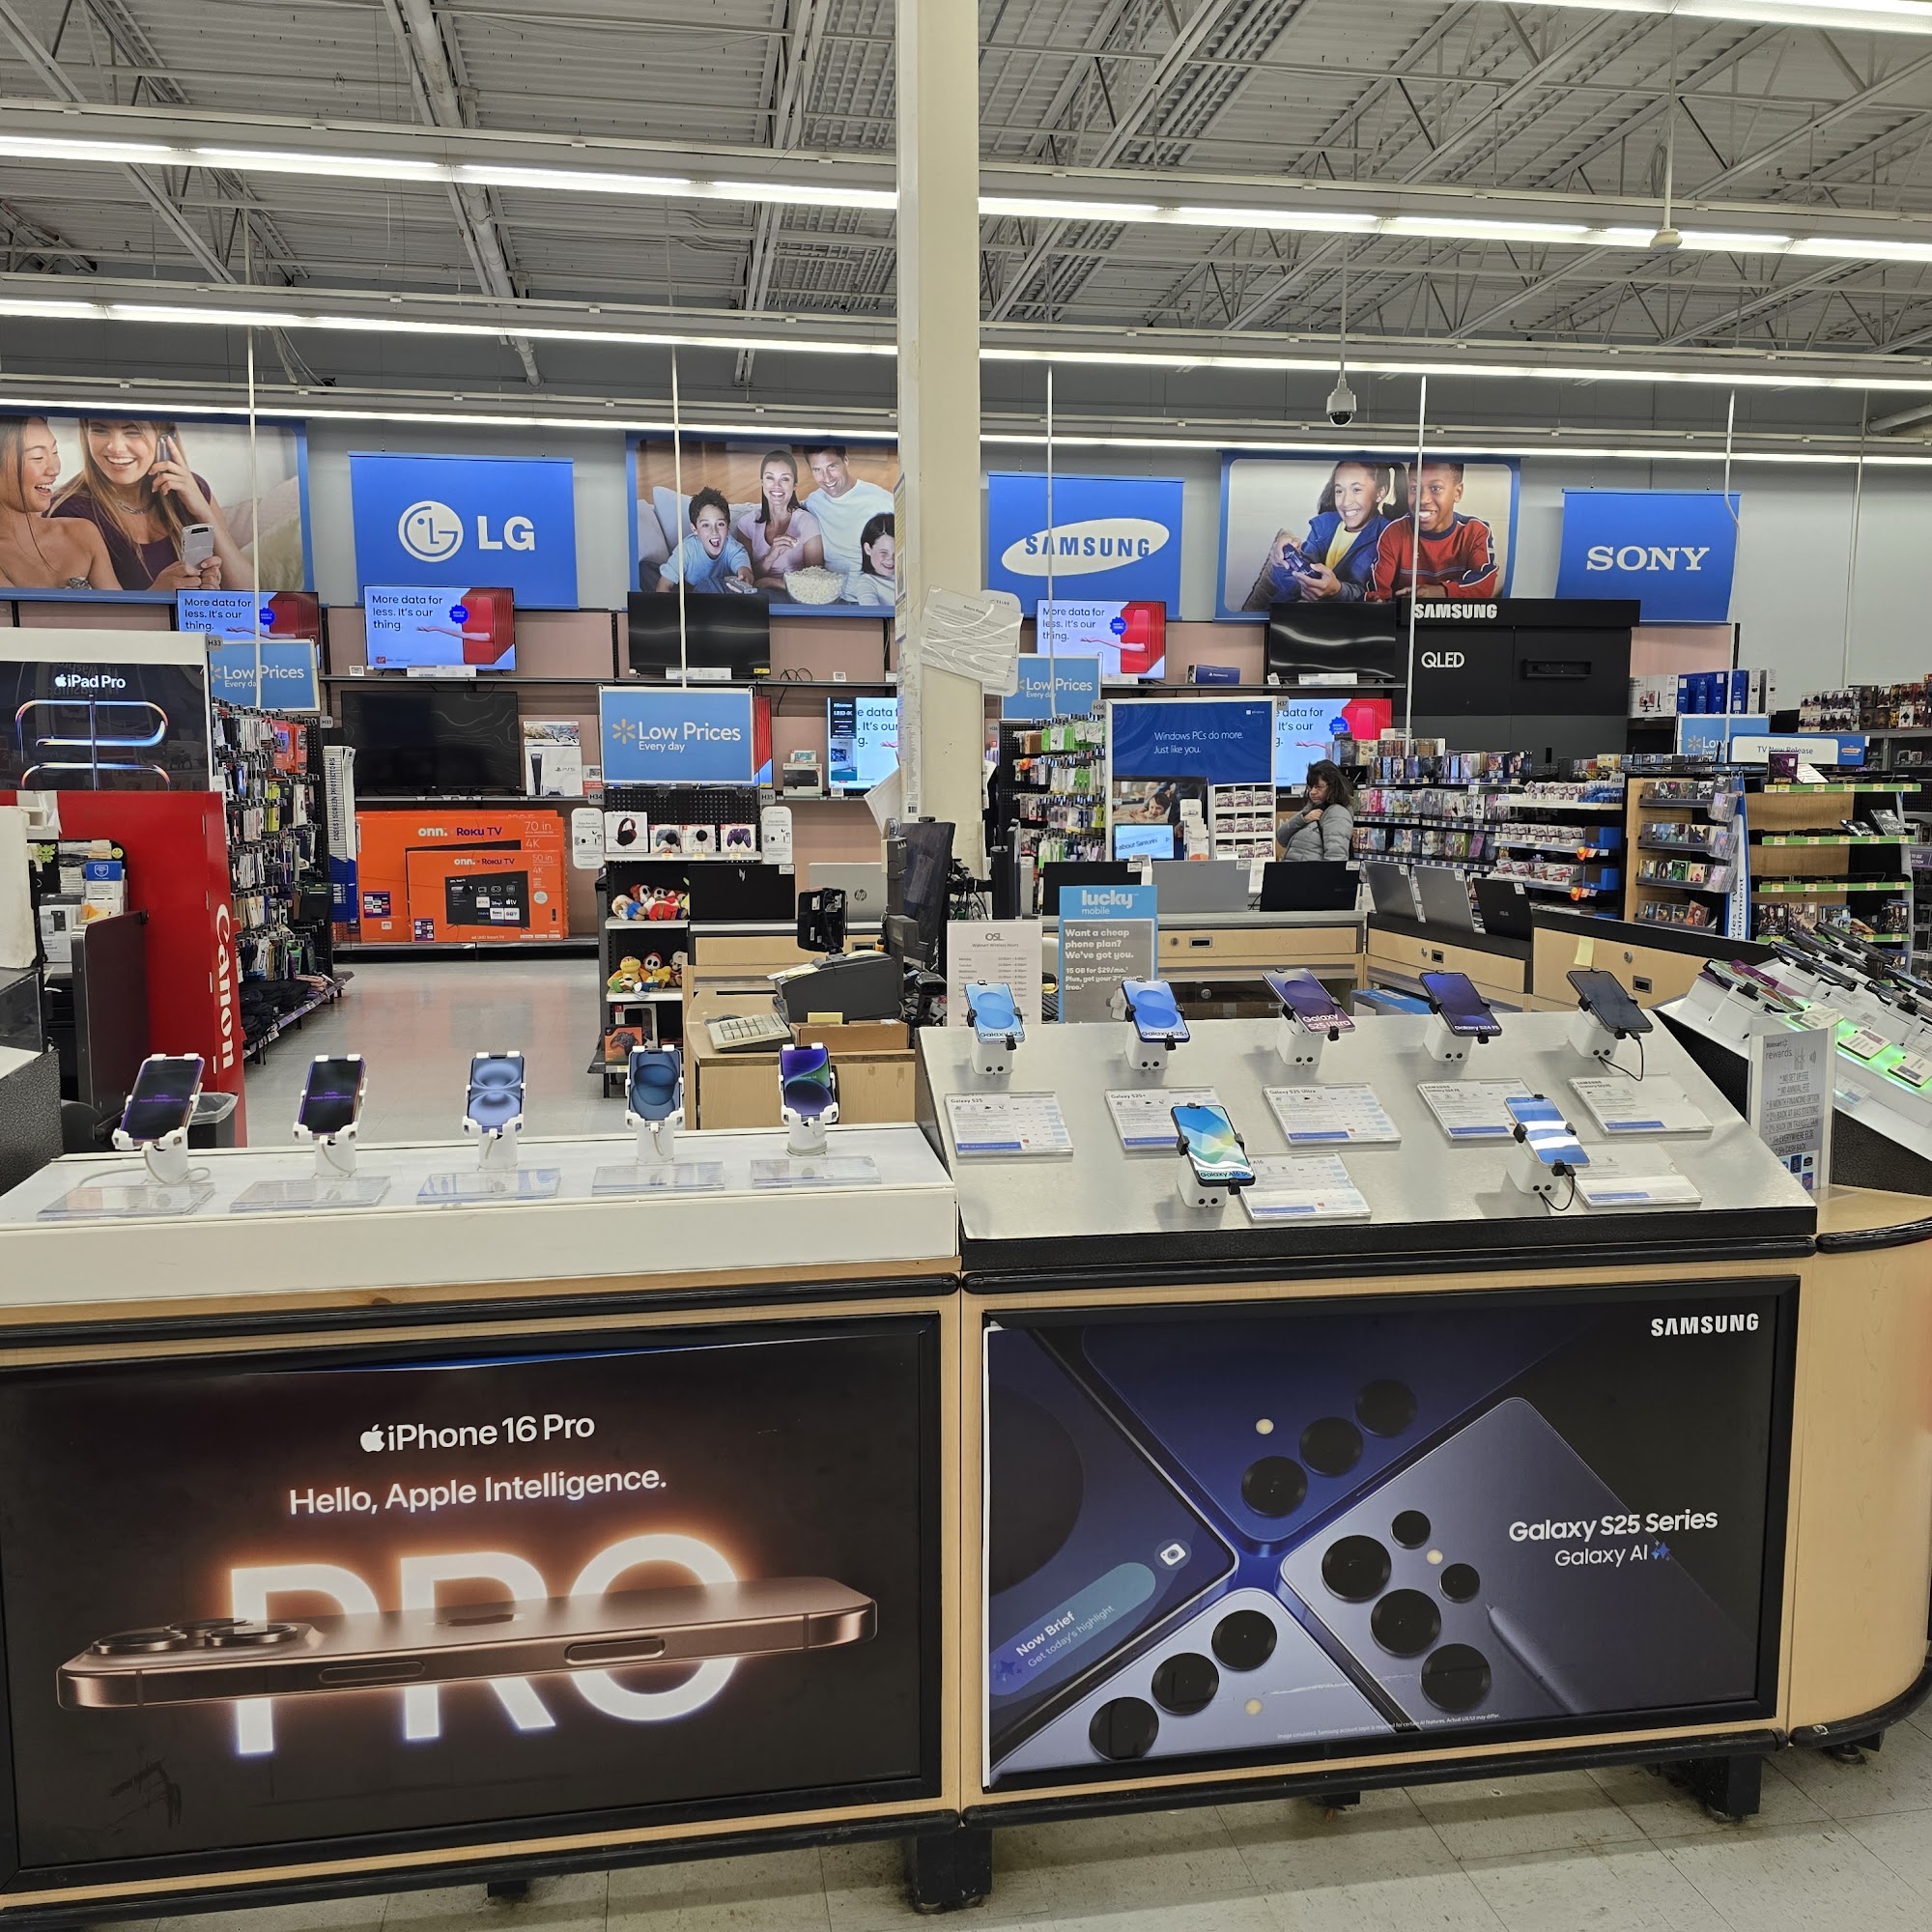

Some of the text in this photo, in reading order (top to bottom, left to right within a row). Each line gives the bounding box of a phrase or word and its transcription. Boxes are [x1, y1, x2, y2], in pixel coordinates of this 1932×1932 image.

[477, 516, 535, 551] LG
[1025, 535, 1150, 557] SAMSUNG
[1586, 545, 1710, 571] SONY
[184, 597, 251, 609] More data for
[372, 595, 443, 606] More data for
[184, 609, 242, 619] less. It's our
[372, 607, 434, 617] less. It's our
[1042, 607, 1105, 616] More data for
[1414, 603, 1497, 619] SAMSUNG
[185, 620, 214, 633] thing.
[1042, 619, 1064, 629] less.
[1065, 619, 1078, 629] It's
[1042, 632, 1069, 642] thing.
[1422, 651, 1465, 668] QLED
[224, 665, 304, 679] Low Prices
[68, 674, 127, 689] iPad Pro
[224, 680, 246, 689] Every
[1026, 678, 1093, 692] Low Prices
[867, 707, 893, 717] data
[1310, 707, 1324, 717] for
[639, 723, 742, 742] Low Prices
[864, 722, 878, 731] It's
[1279, 723, 1314, 731] It's our
[1154, 732, 1190, 741] Windows
[1192, 731, 1208, 740] PCs
[1208, 731, 1220, 740] do
[639, 742, 685, 753] Every day
[1154, 746, 1169, 754] Just
[418, 827, 502, 837] onn. Roku TV
[526, 838, 540, 848] 4K
[1119, 837, 1158, 851] about Santorini
[1082, 889, 1133, 909] lucky
[1082, 906, 1111, 915] mobile
[985, 933, 1005, 942] OSL
[1065, 928, 1091, 937] Want
[1101, 928, 1129, 940] cheap
[1065, 939, 1122, 951] phone plan?
[1065, 951, 1134, 961] We've got you.
[216, 903, 235, 1069] Canon
[1302, 1013, 1339, 1023] Galaxy
[1308, 1020, 1352, 1031] S25 Ultra
[1650, 1313, 1759, 1337] SAMSUNG
[387, 1412, 596, 1452] iPhone 16 Pro
[290, 1468, 668, 1516] Hello, Apple Intelligence.
[1509, 1509, 1719, 1542] Galaxy S25 Series
[1554, 1545, 1648, 1568] Galaxy AI
[1015, 1610, 1076, 1658] Now Brief
[1027, 1605, 1115, 1668] Get today's highlight
[230, 1533, 739, 1755] PRO
